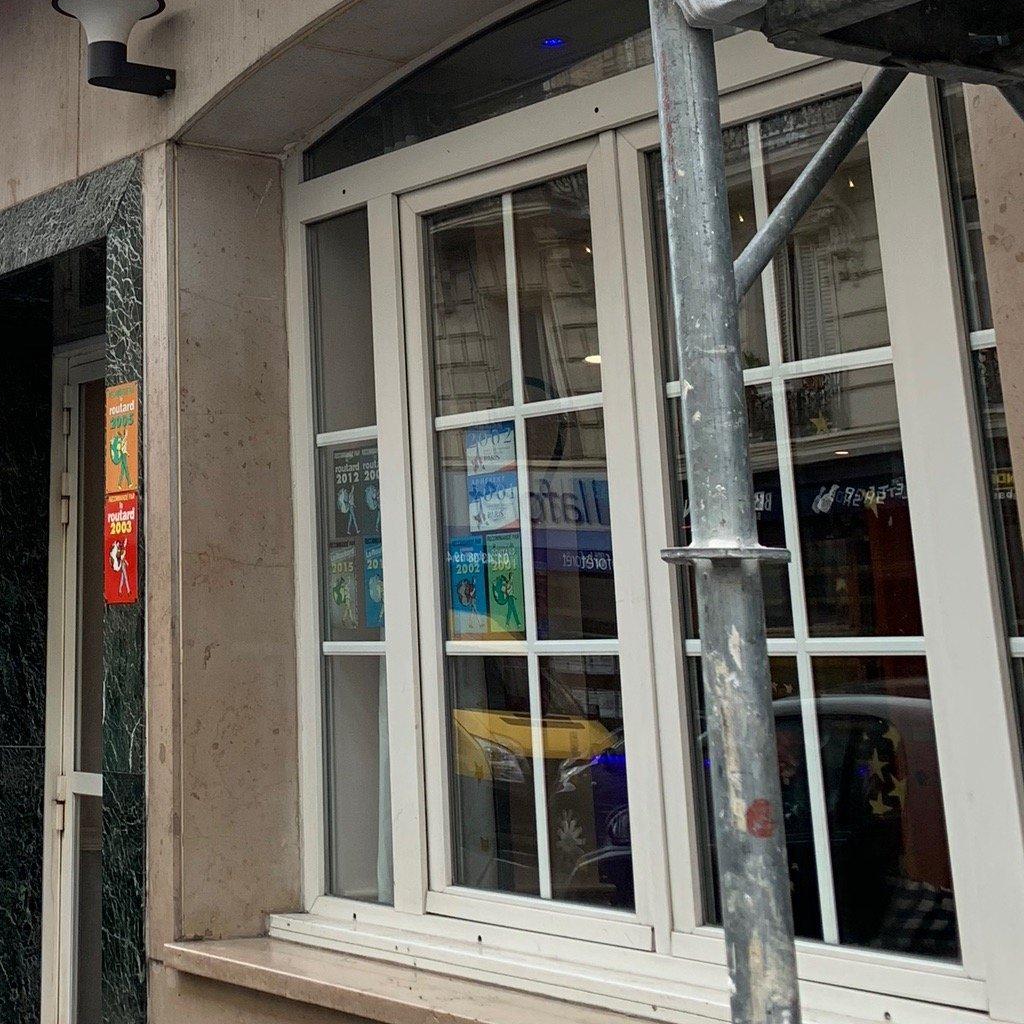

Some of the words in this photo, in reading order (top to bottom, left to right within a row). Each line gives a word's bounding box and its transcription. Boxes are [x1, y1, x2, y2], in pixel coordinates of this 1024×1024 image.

[109, 400, 135, 416] routard
[335, 462, 360, 474] routard
[336, 472, 360, 484] 2012
[107, 507, 135, 523] routard
[110, 521, 133, 535] 2003
[331, 561, 354, 574] 2015
[456, 563, 481, 575] 2002
